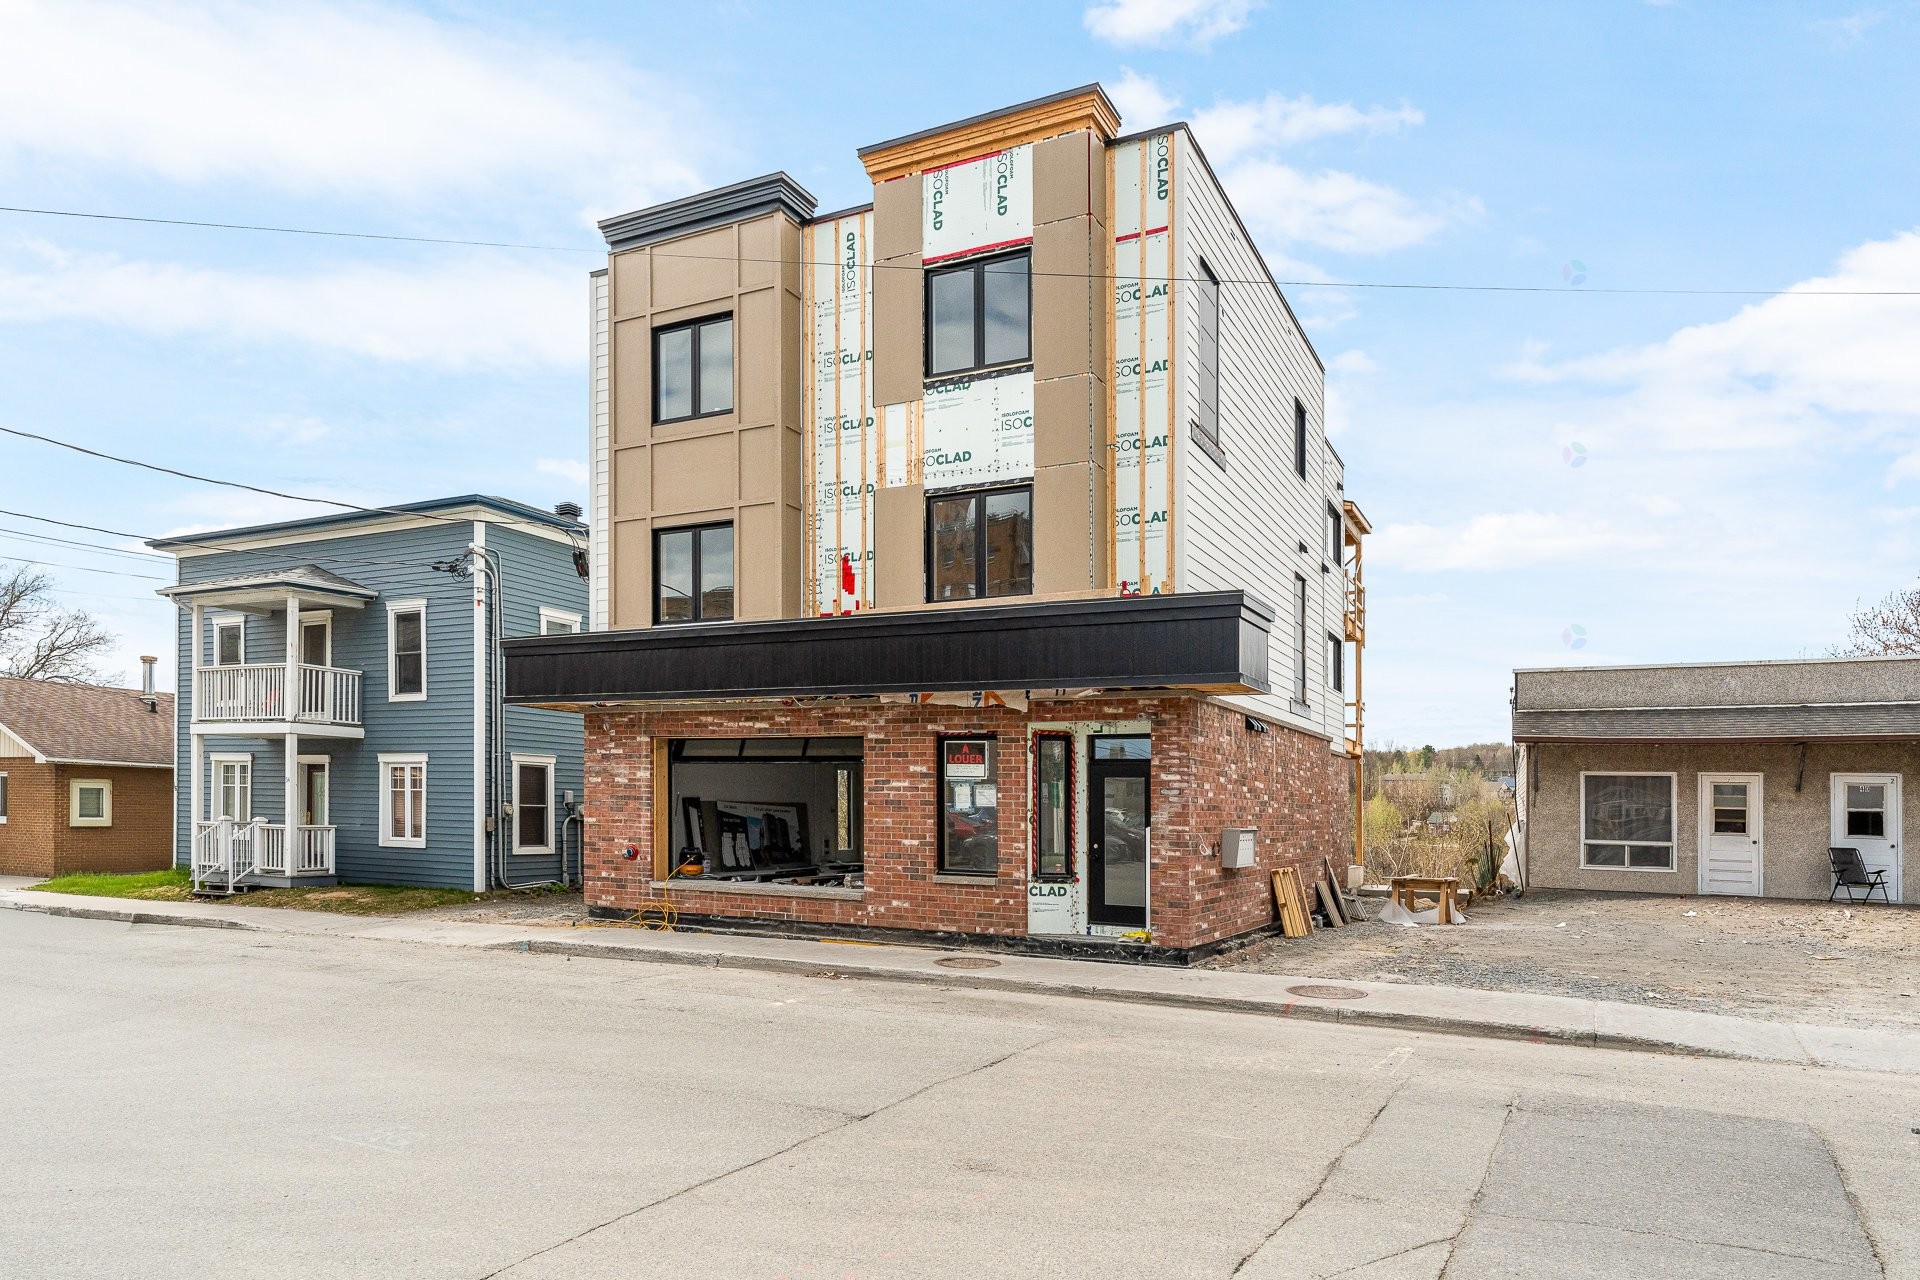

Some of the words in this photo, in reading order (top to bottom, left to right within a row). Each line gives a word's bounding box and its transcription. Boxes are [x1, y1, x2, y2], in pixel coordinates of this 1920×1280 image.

[846, 232, 856, 292] ISOCLAD
[949, 754, 983, 764] LOUER
[1028, 885, 1068, 897] CLAD
